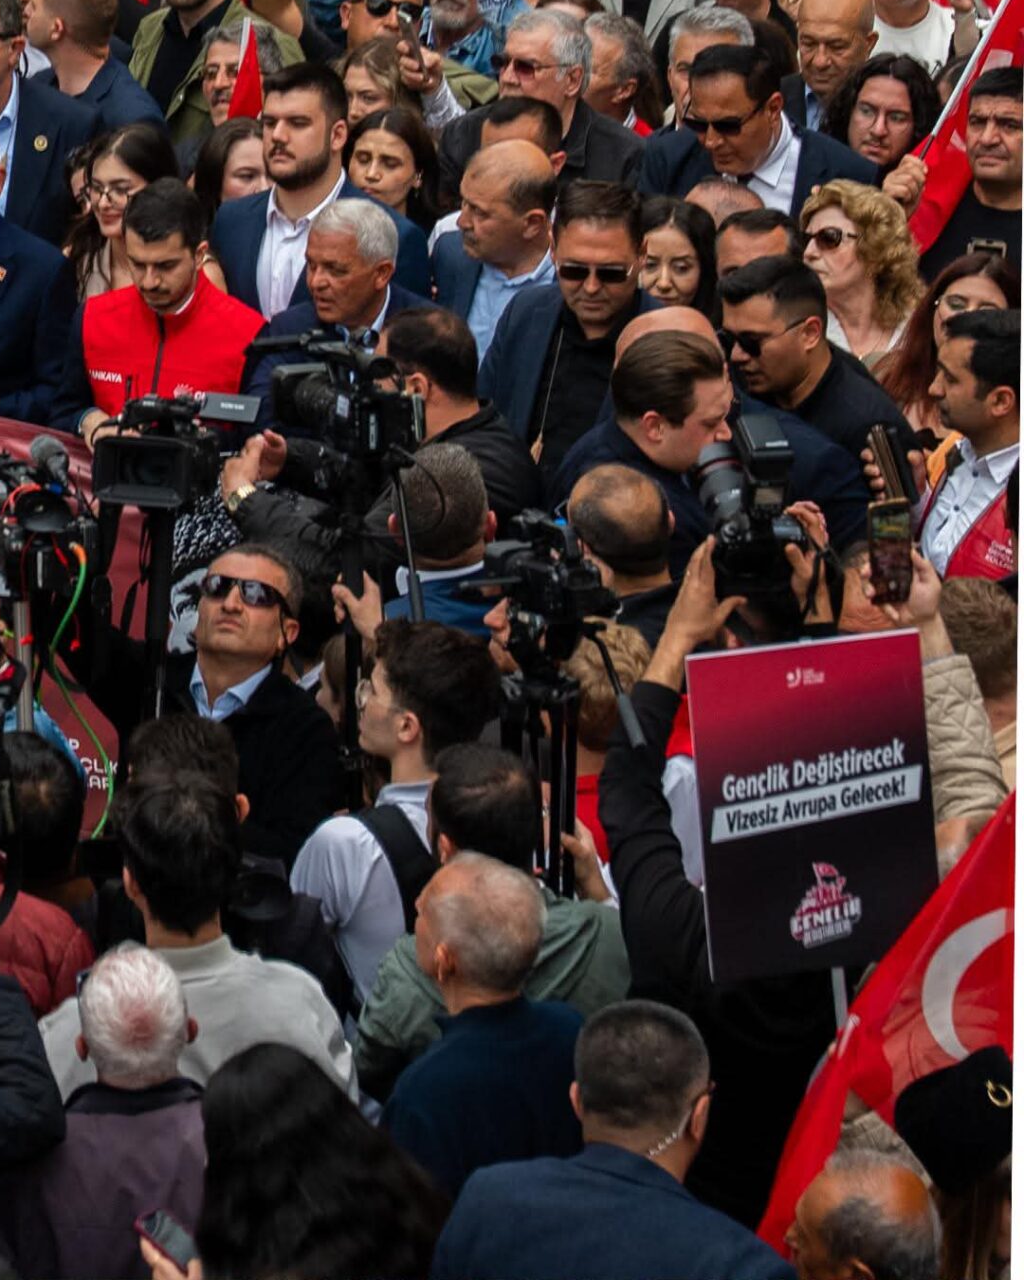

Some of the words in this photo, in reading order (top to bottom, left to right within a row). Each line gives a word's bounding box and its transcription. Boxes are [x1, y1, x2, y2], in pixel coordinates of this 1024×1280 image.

[722, 763, 789, 803] Gençlik
[792, 737, 906, 786] Değiştirecek
[726, 804, 779, 834] Vizesiz
[782, 794, 837, 823] Avrupa
[840, 775, 907, 808] Gelecek!
